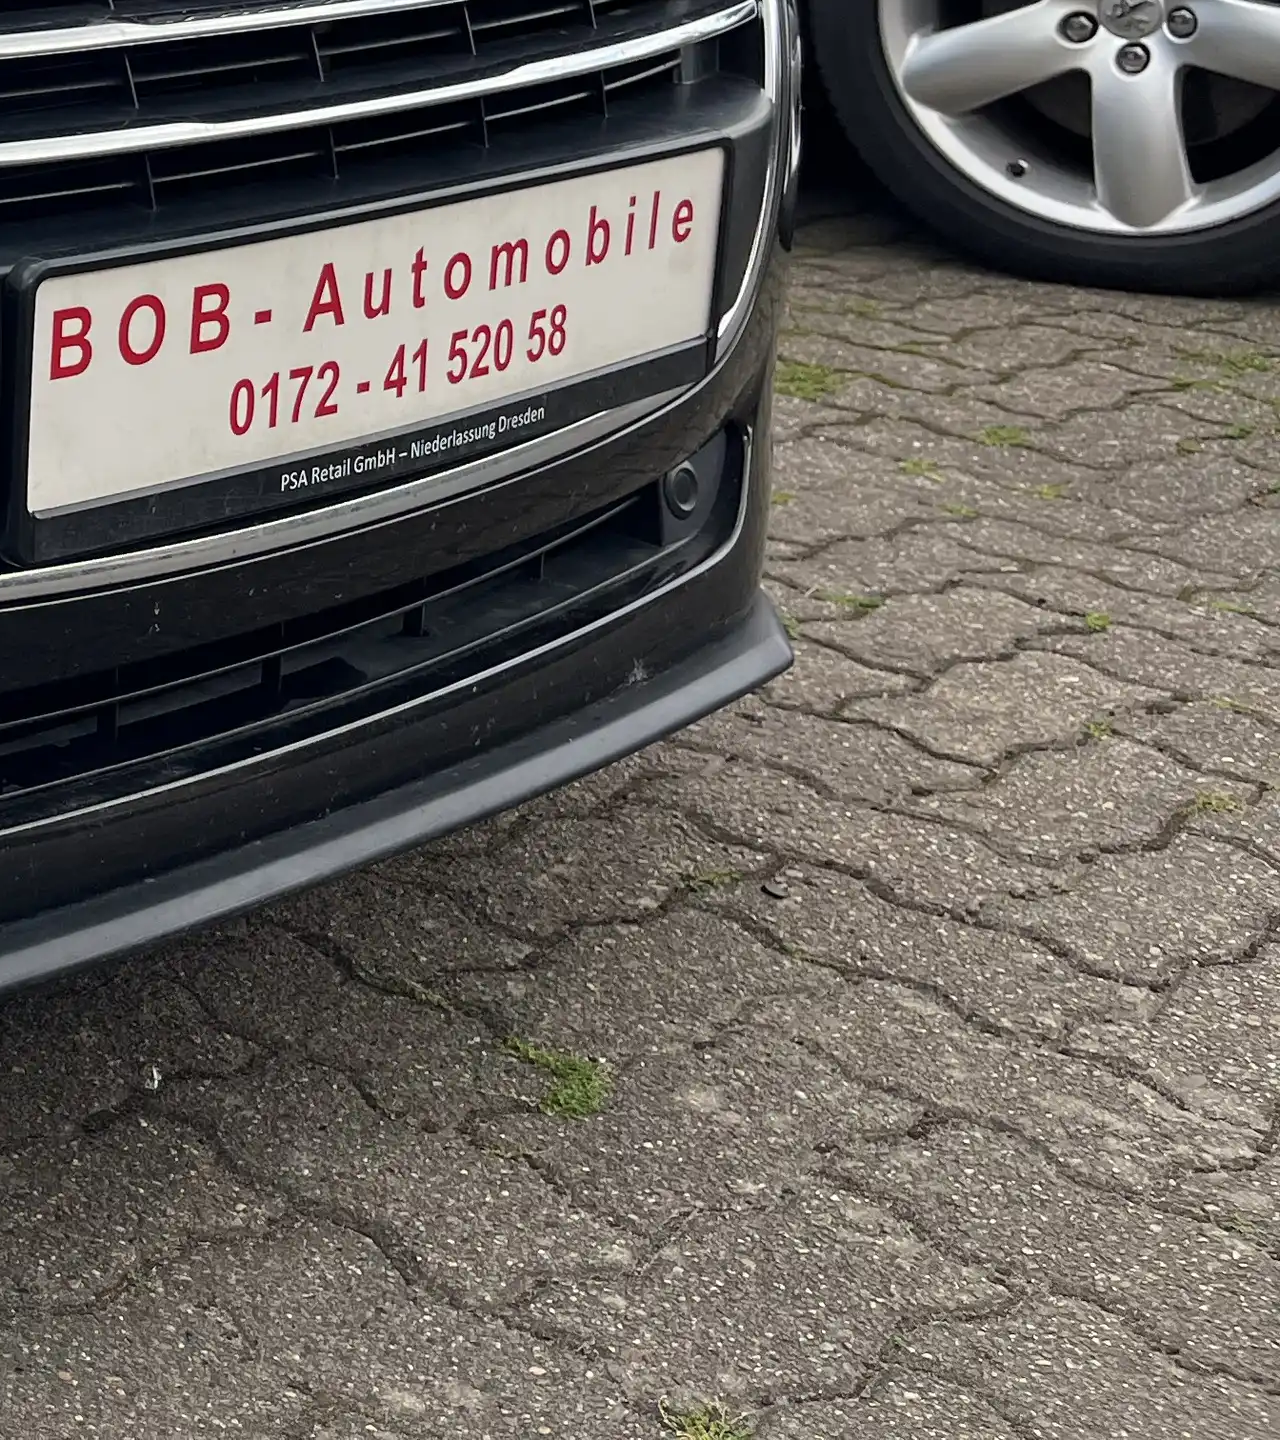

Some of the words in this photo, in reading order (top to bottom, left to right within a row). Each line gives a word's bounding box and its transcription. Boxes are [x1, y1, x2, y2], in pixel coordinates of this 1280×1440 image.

[303, 192, 694, 331] Automobile
[229, 360, 341, 436] 0172
[383, 339, 428, 398] 41
[447, 319, 514, 384] 520
[527, 304, 568, 362] 58
[280, 468, 309, 492] PSA
[311, 457, 351, 486] Retail
[353, 447, 397, 474] GmbH
[410, 421, 497, 460] Niederlassung
[498, 406, 546, 433] Dresden
